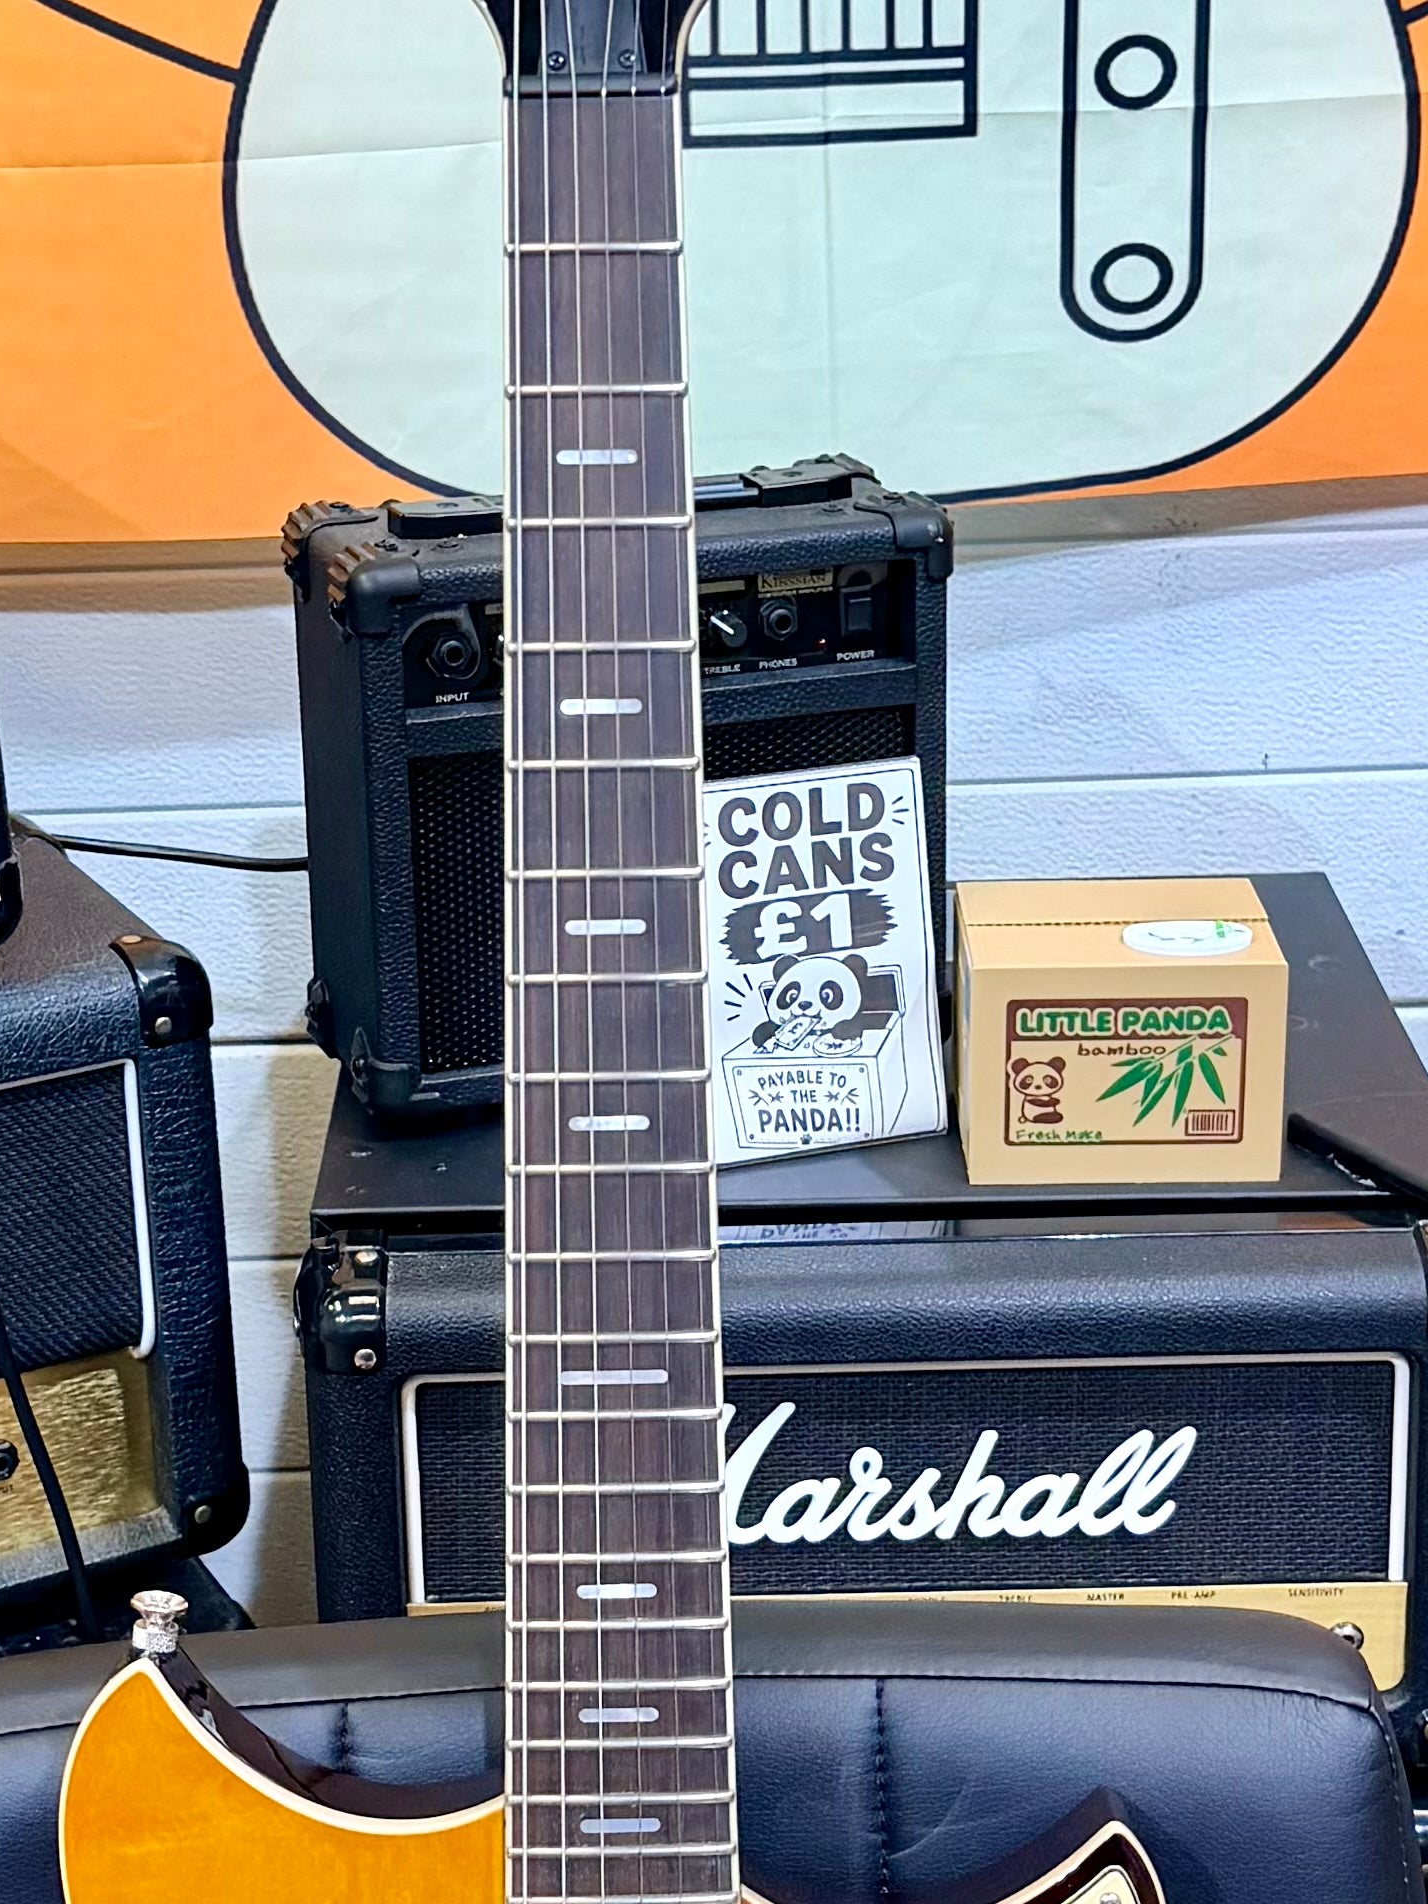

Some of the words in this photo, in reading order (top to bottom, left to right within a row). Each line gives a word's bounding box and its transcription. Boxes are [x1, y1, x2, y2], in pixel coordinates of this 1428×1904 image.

[836, 650, 875, 661] POWER
[704, 664, 741, 675] TREBLE
[759, 658, 798, 669] PHONES
[435, 692, 470, 703] INPUT
[718, 782, 885, 847] COLD
[718, 832, 895, 899] CANS
[754, 893, 853, 960] £1
[1017, 1008, 1115, 1036] LITTLE
[1121, 1006, 1232, 1034] PANDA
[1077, 1043, 1167, 1057] bamboo
[758, 1070, 823, 1090] PAYABLE
[829, 1072, 847, 1088] TO
[790, 1089, 818, 1103] THE
[758, 1107, 861, 1134] PANDA!!
[1087, 1592, 1125, 1602] MASTER
[1287, 1587, 1344, 1597] SENSITIVITY
